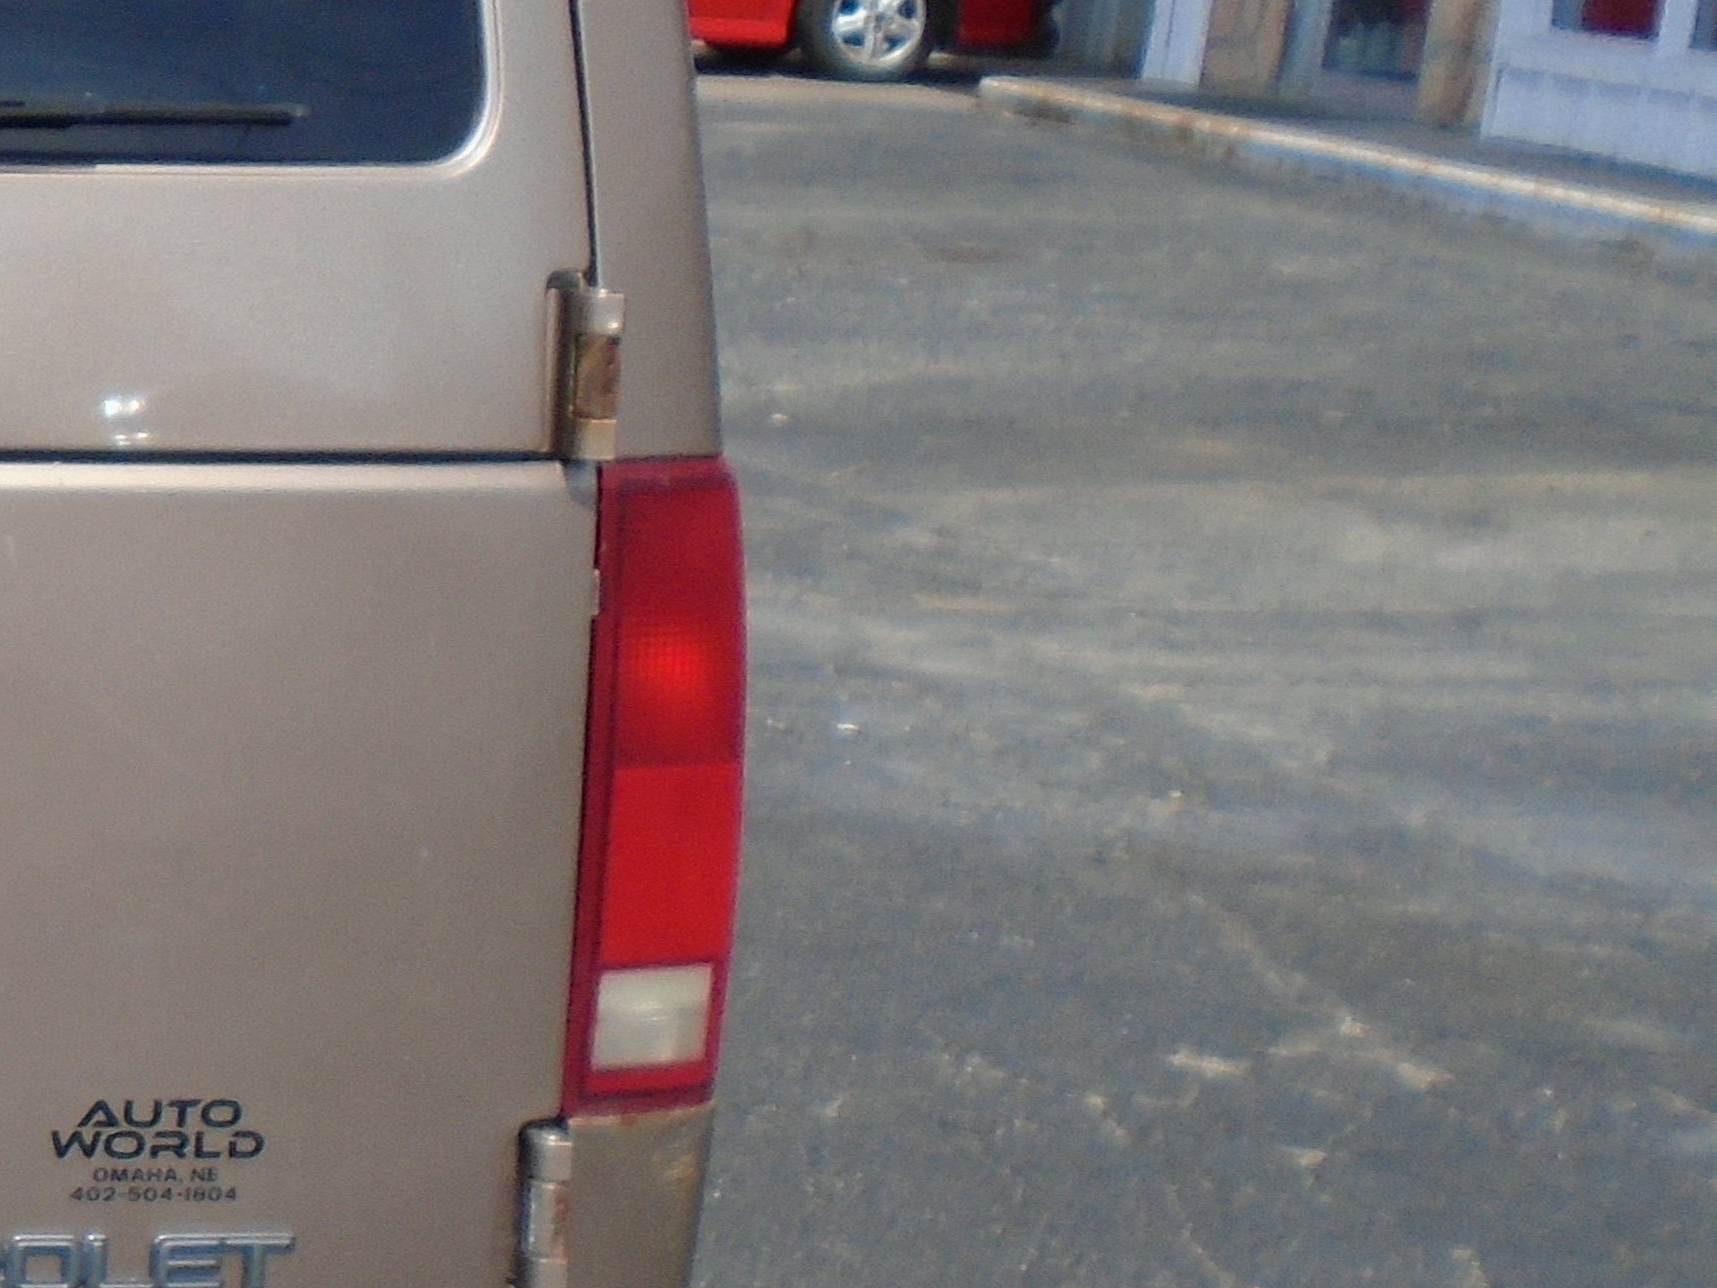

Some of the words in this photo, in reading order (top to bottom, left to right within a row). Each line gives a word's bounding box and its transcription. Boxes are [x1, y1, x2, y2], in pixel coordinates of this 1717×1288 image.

[77, 1098, 243, 1128] AUTO
[51, 1130, 265, 1160] WORLD
[190, 1168, 219, 1182] NE
[69, 1186, 237, 1202] 402-504-1804
